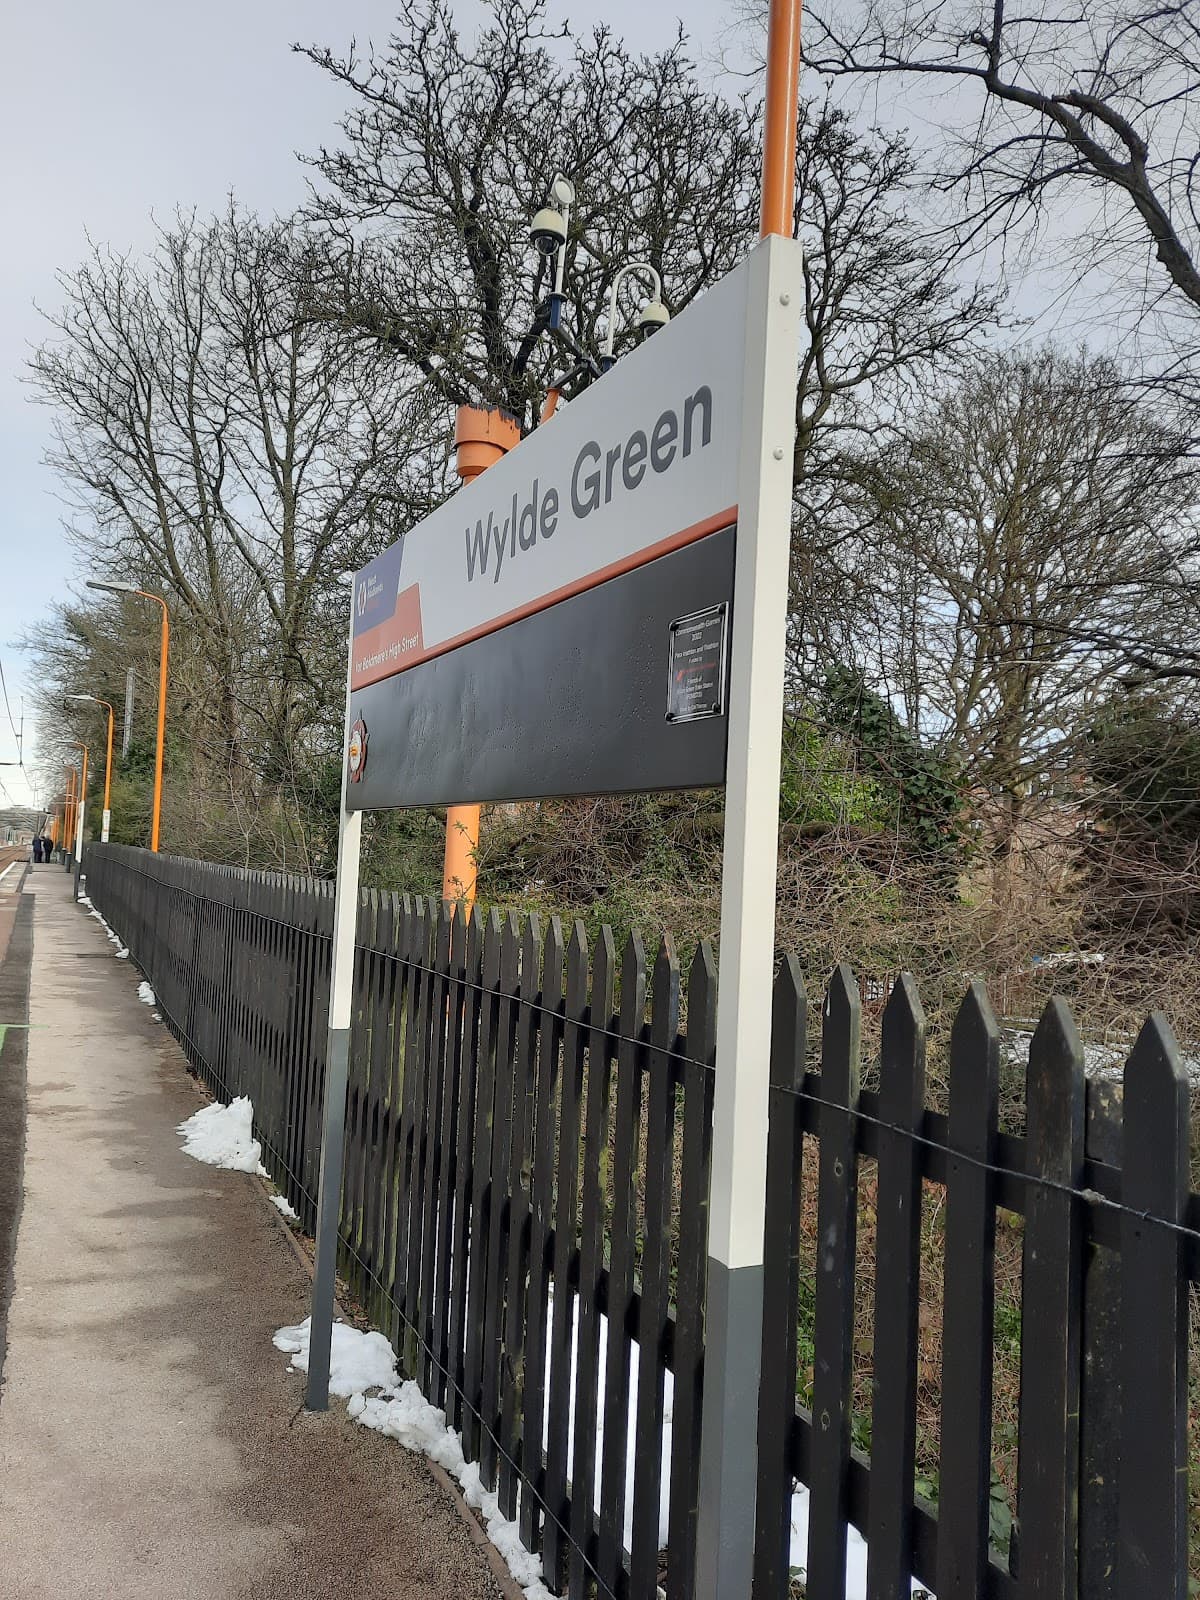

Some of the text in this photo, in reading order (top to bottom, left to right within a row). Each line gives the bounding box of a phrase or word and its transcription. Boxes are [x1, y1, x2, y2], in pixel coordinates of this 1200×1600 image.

[465, 384, 713, 584] Wylde Green
[388, 641, 401, 659] High
[401, 631, 419, 653] Street
